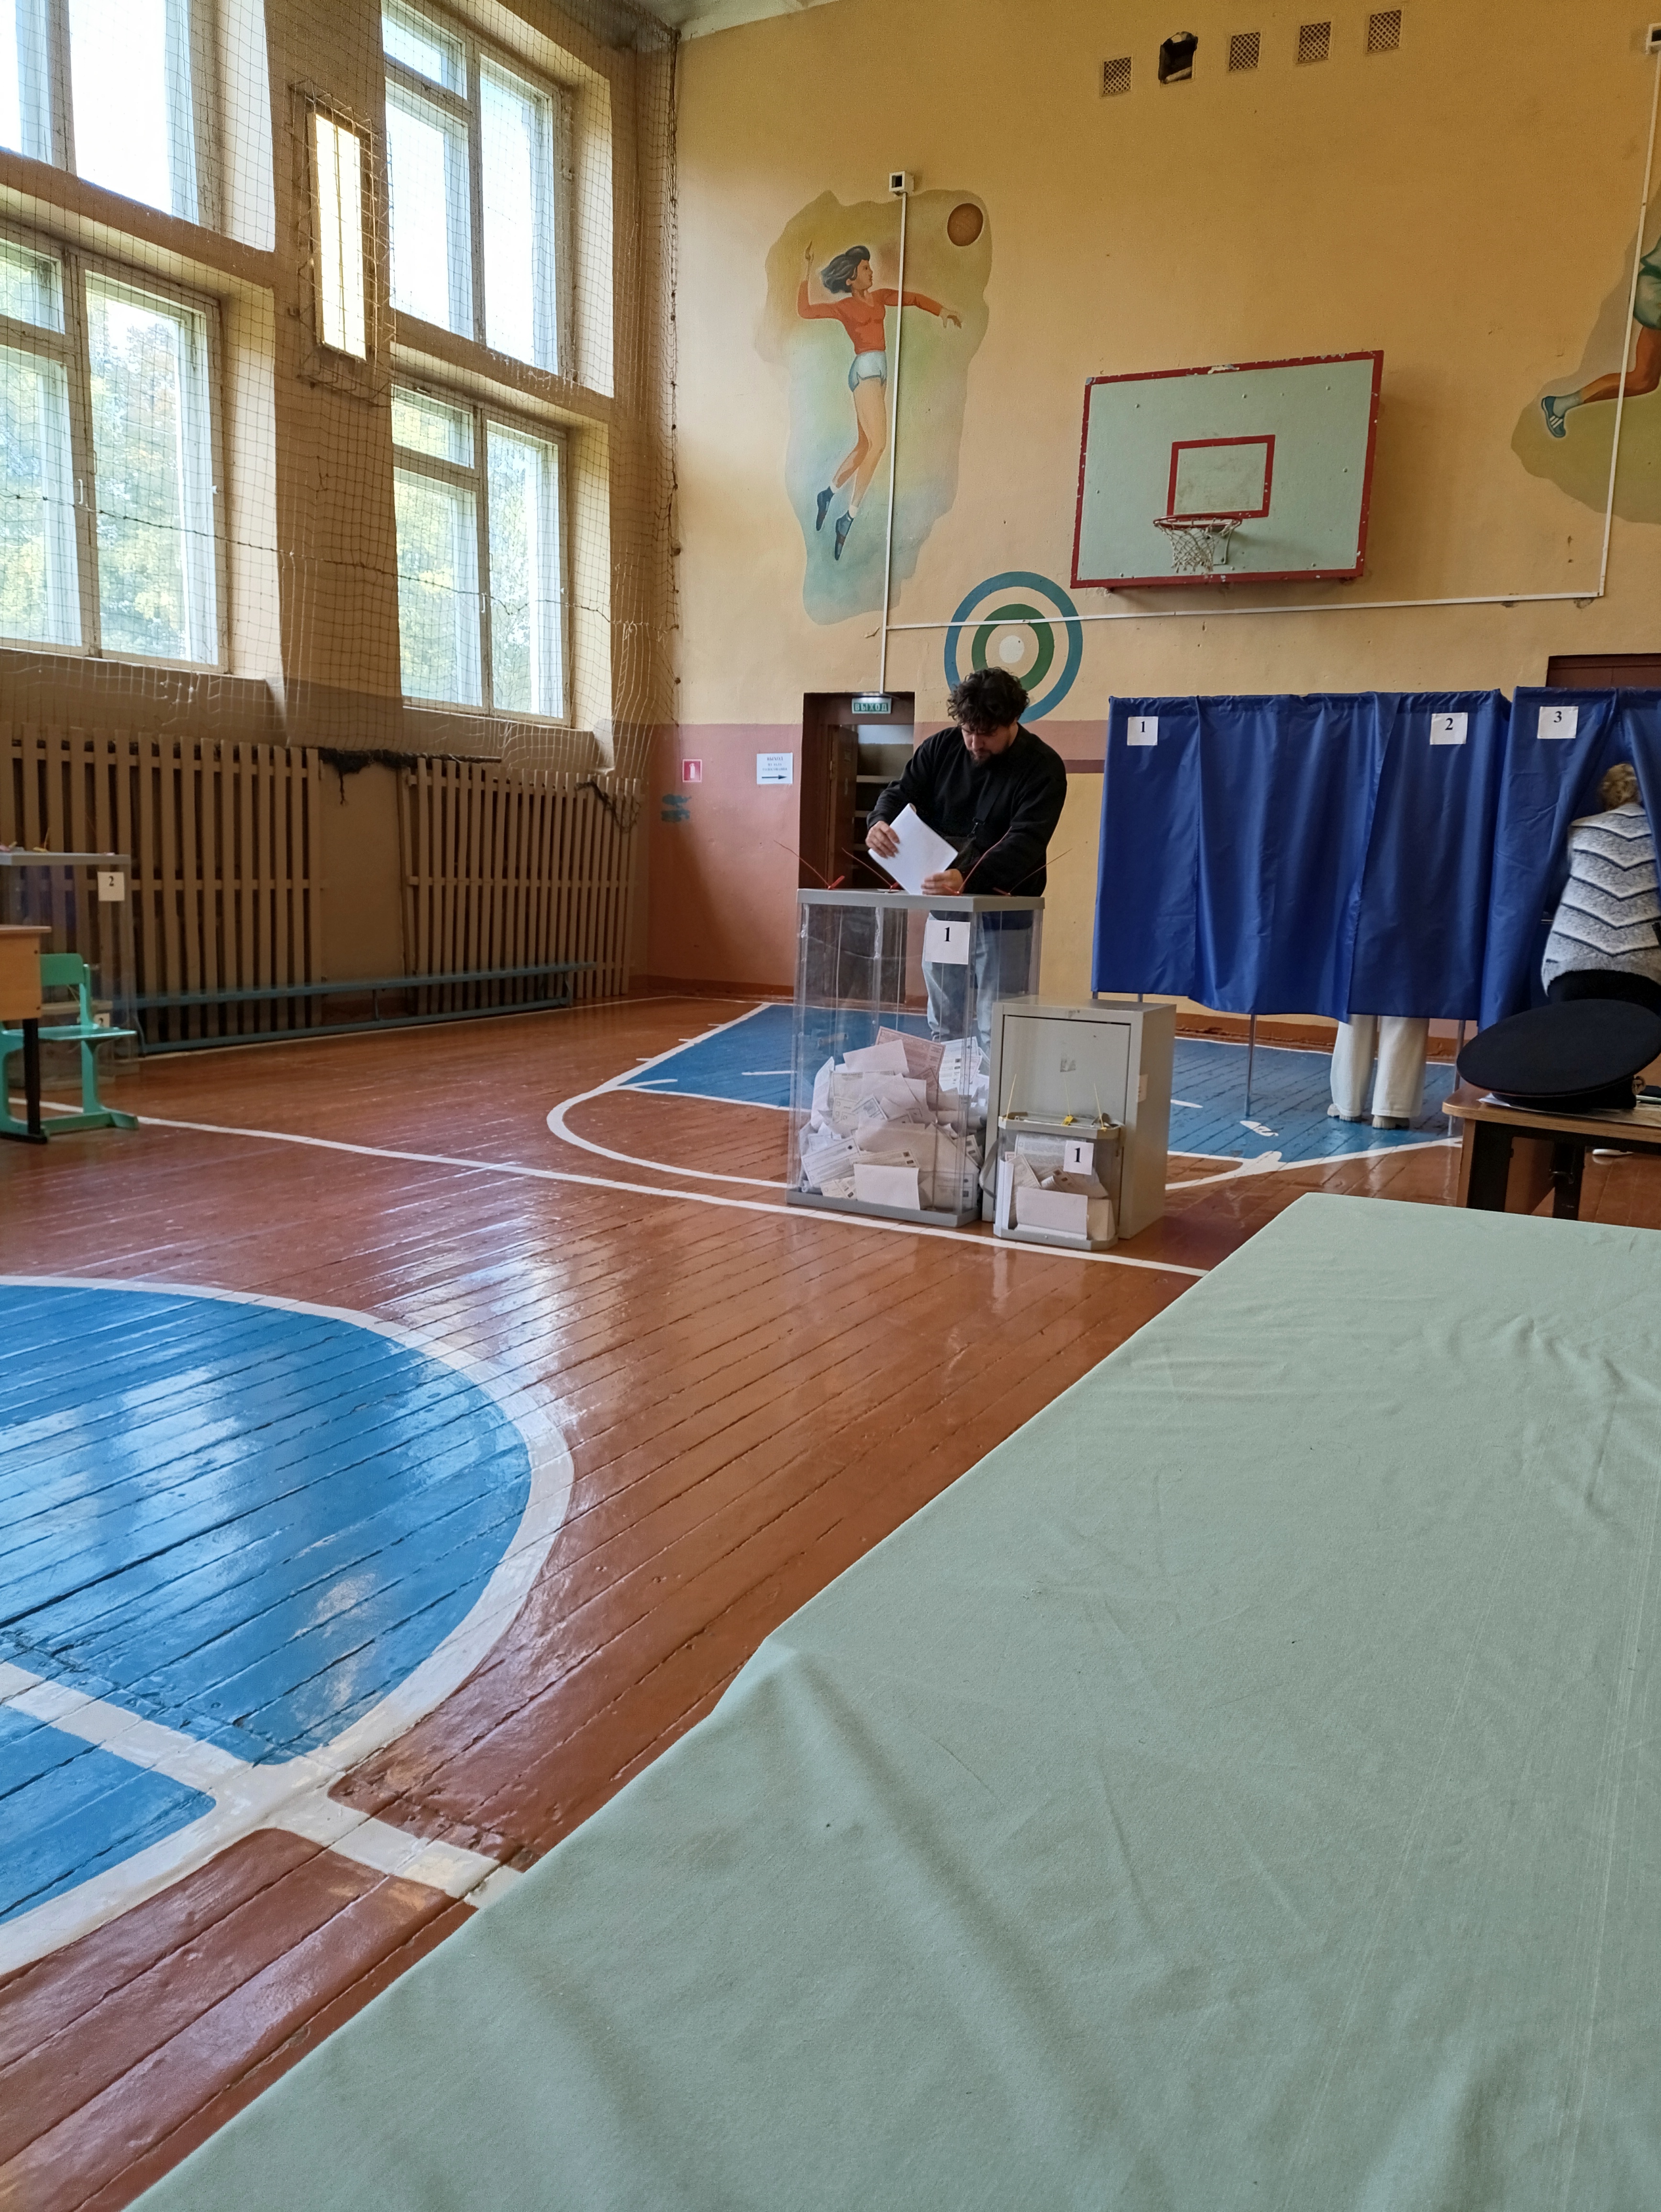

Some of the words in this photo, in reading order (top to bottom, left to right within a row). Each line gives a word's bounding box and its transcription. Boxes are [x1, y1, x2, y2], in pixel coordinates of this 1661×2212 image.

[854, 703, 888, 711] ВЫХОД
[1553, 711, 1562, 723] 3
[1140, 721, 1146, 732] 1
[1445, 718, 1453, 730] 2
[108, 875, 114, 887] 2
[943, 926, 951, 942] 1
[1074, 1147, 1081, 1163] 1
